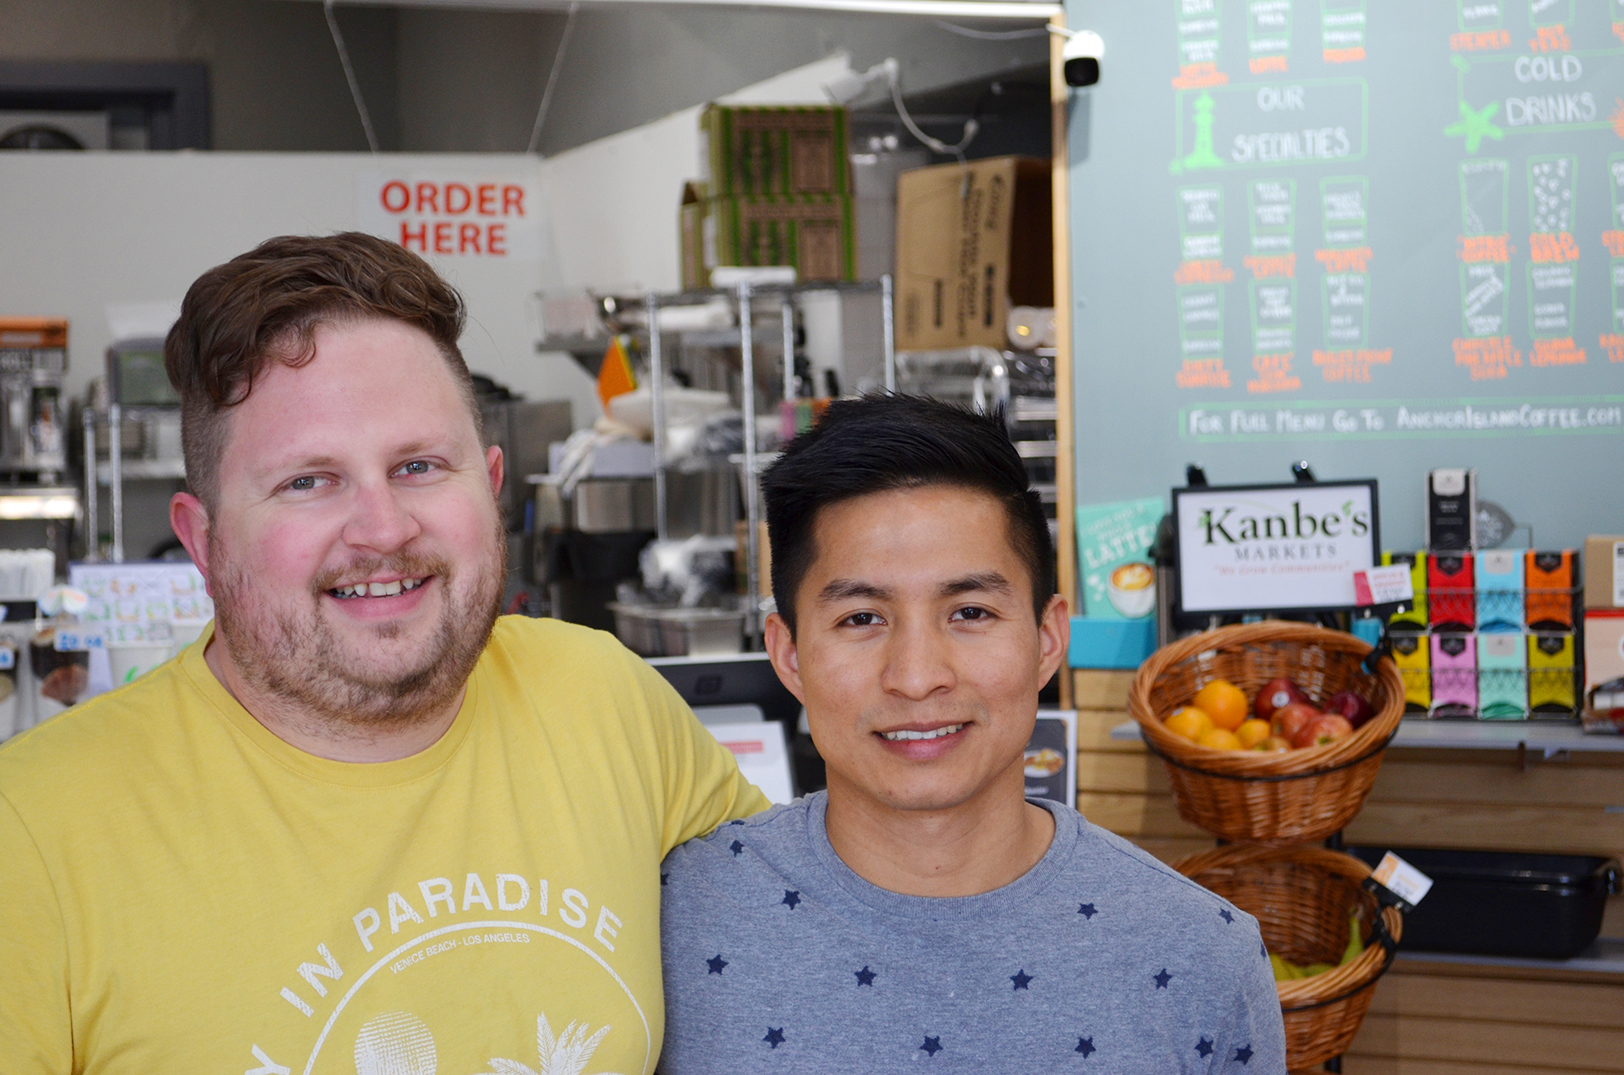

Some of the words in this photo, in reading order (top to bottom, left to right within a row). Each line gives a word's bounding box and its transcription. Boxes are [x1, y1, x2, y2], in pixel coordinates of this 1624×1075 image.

[1514, 55, 1583, 83] COLD
[1257, 85, 1305, 112] OUR
[1505, 91, 1596, 126] DRINKS
[380, 179, 526, 217] ORDER
[401, 221, 507, 256] HERE
[1189, 409, 1224, 436] FOR
[1230, 409, 1270, 435] FULL
[1275, 408, 1326, 434] MENU
[1200, 500, 1369, 545] Kanbe's
[1085, 522, 1157, 570] LATTE
[1235, 542, 1337, 561] MARKETS
[280, 942, 344, 1018] IN
[352, 872, 623, 953] PARADISE
[390, 950, 425, 975] VENICE
[425, 939, 457, 957] BEACH
[462, 934, 482, 946] LOS
[484, 933, 530, 944] ANGELES
